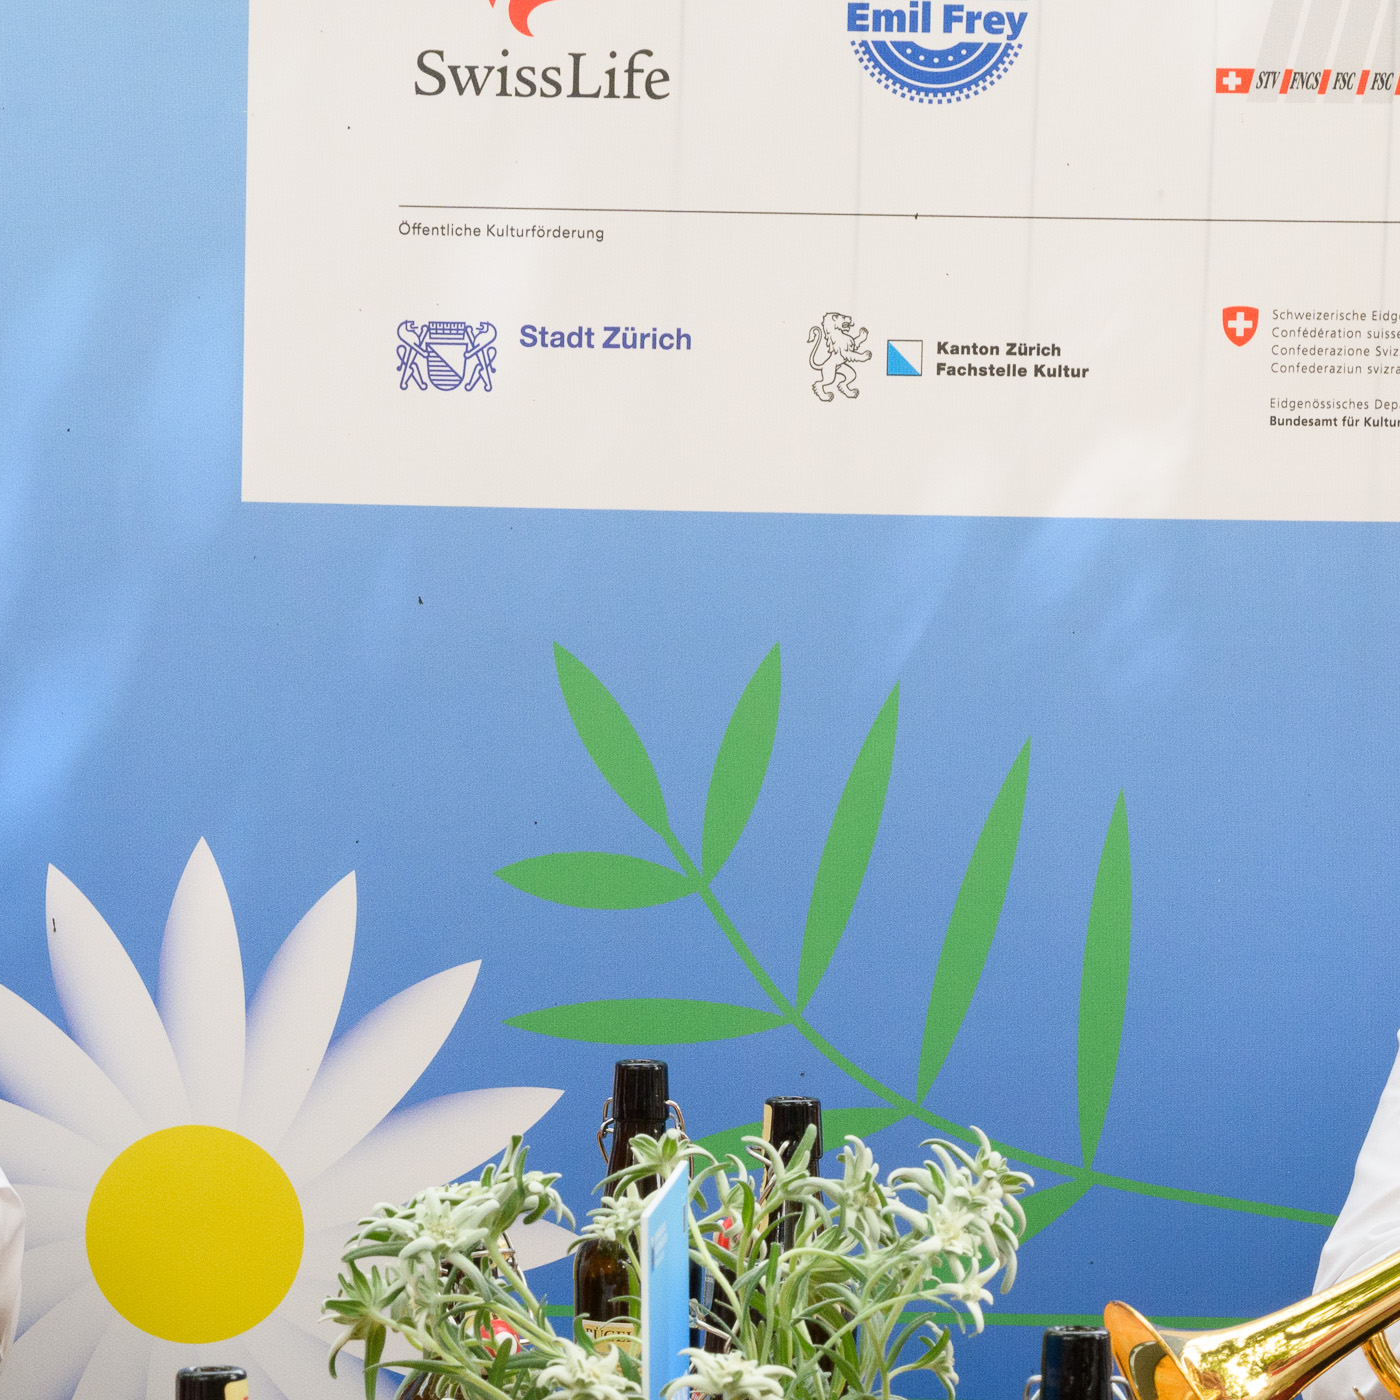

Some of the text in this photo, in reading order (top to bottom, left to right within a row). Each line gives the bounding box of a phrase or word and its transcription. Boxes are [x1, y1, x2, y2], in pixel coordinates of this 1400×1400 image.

[847, 1, 1028, 41] Emil Frey
[1255, 70, 1395, 91] STV FNCS FSC FSC
[398, 219, 605, 243] Öffentliche Kulturförderung
[1272, 308, 1367, 322] Schweizerische
[519, 324, 692, 351] Stadt Zürich
[1271, 326, 1362, 340] Confédération
[936, 341, 1062, 357] Kanton Zürich
[1271, 344, 1370, 357] Confederazione
[936, 362, 1090, 379] Fachstelle Kultur
[1270, 362, 1362, 375] Confederaziun
[1269, 398, 1370, 413] Eidgenössisches
[1269, 415, 1338, 428] Bundesamt
[1341, 415, 1360, 428] für
